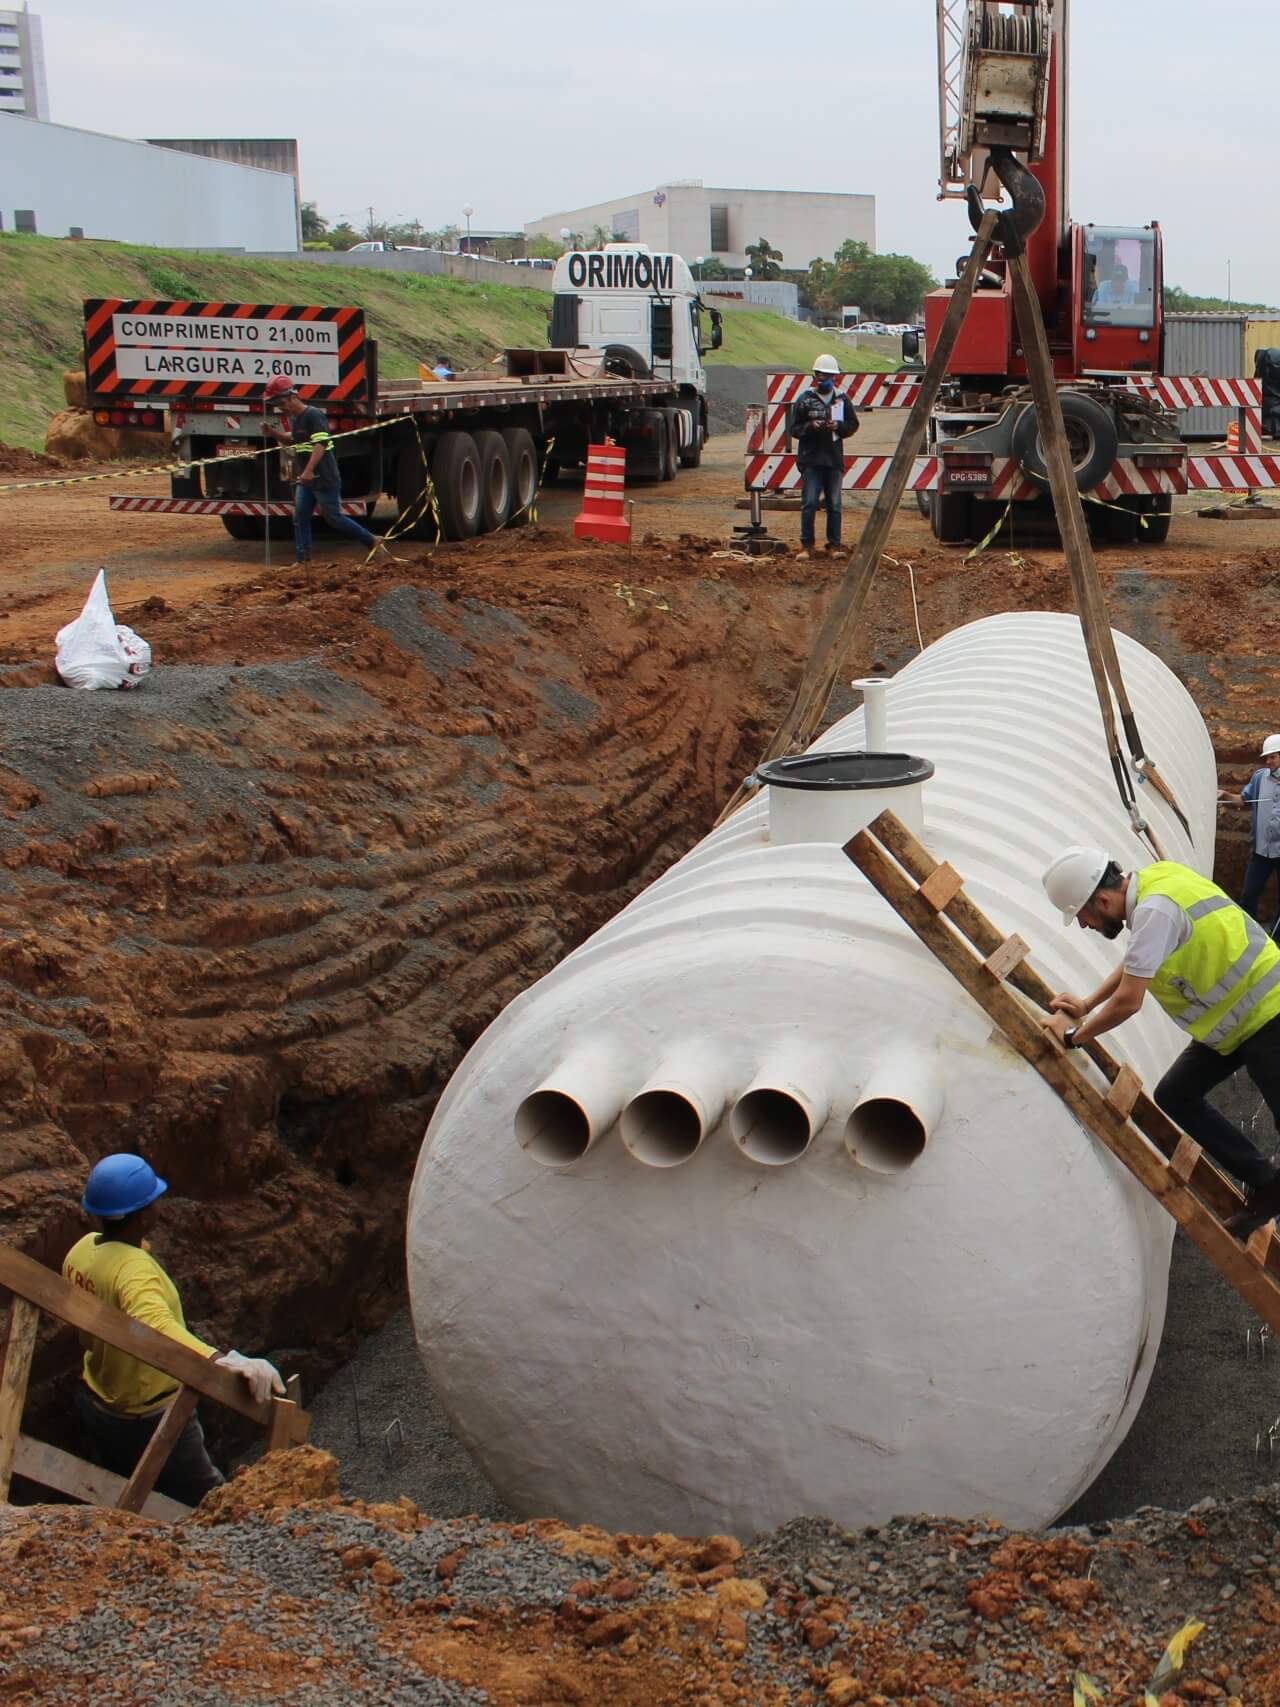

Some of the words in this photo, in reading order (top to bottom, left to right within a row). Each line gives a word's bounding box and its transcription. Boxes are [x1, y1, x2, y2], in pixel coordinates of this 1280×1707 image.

[568, 253, 673, 289] ORIMOM
[121, 321, 259, 341] COMPRIMENTO
[268, 326, 331, 344] 21,00m
[144, 356, 244, 374] LARGURA
[254, 359, 311, 377] 2,60m
